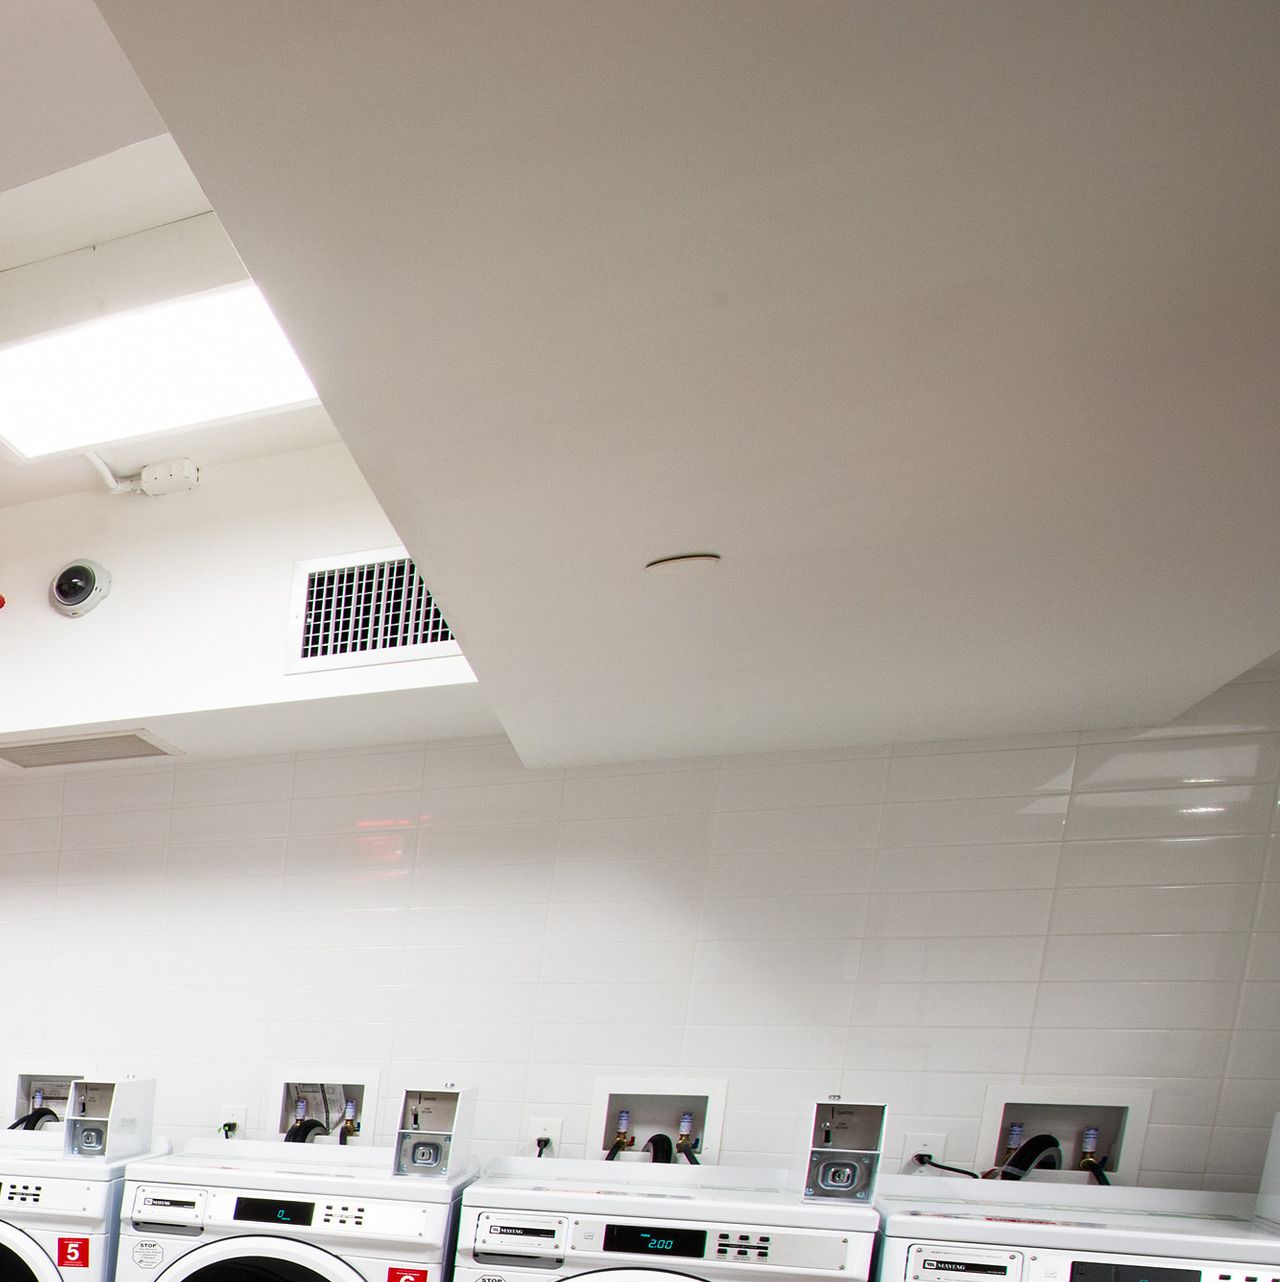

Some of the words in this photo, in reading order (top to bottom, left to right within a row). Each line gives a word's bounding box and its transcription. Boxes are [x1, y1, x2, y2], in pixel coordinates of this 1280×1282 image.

[648, 1239, 673, 1249] 2.00
[66, 1243, 80, 1261] 5
[937, 1262, 966, 1270] MAYTAG
